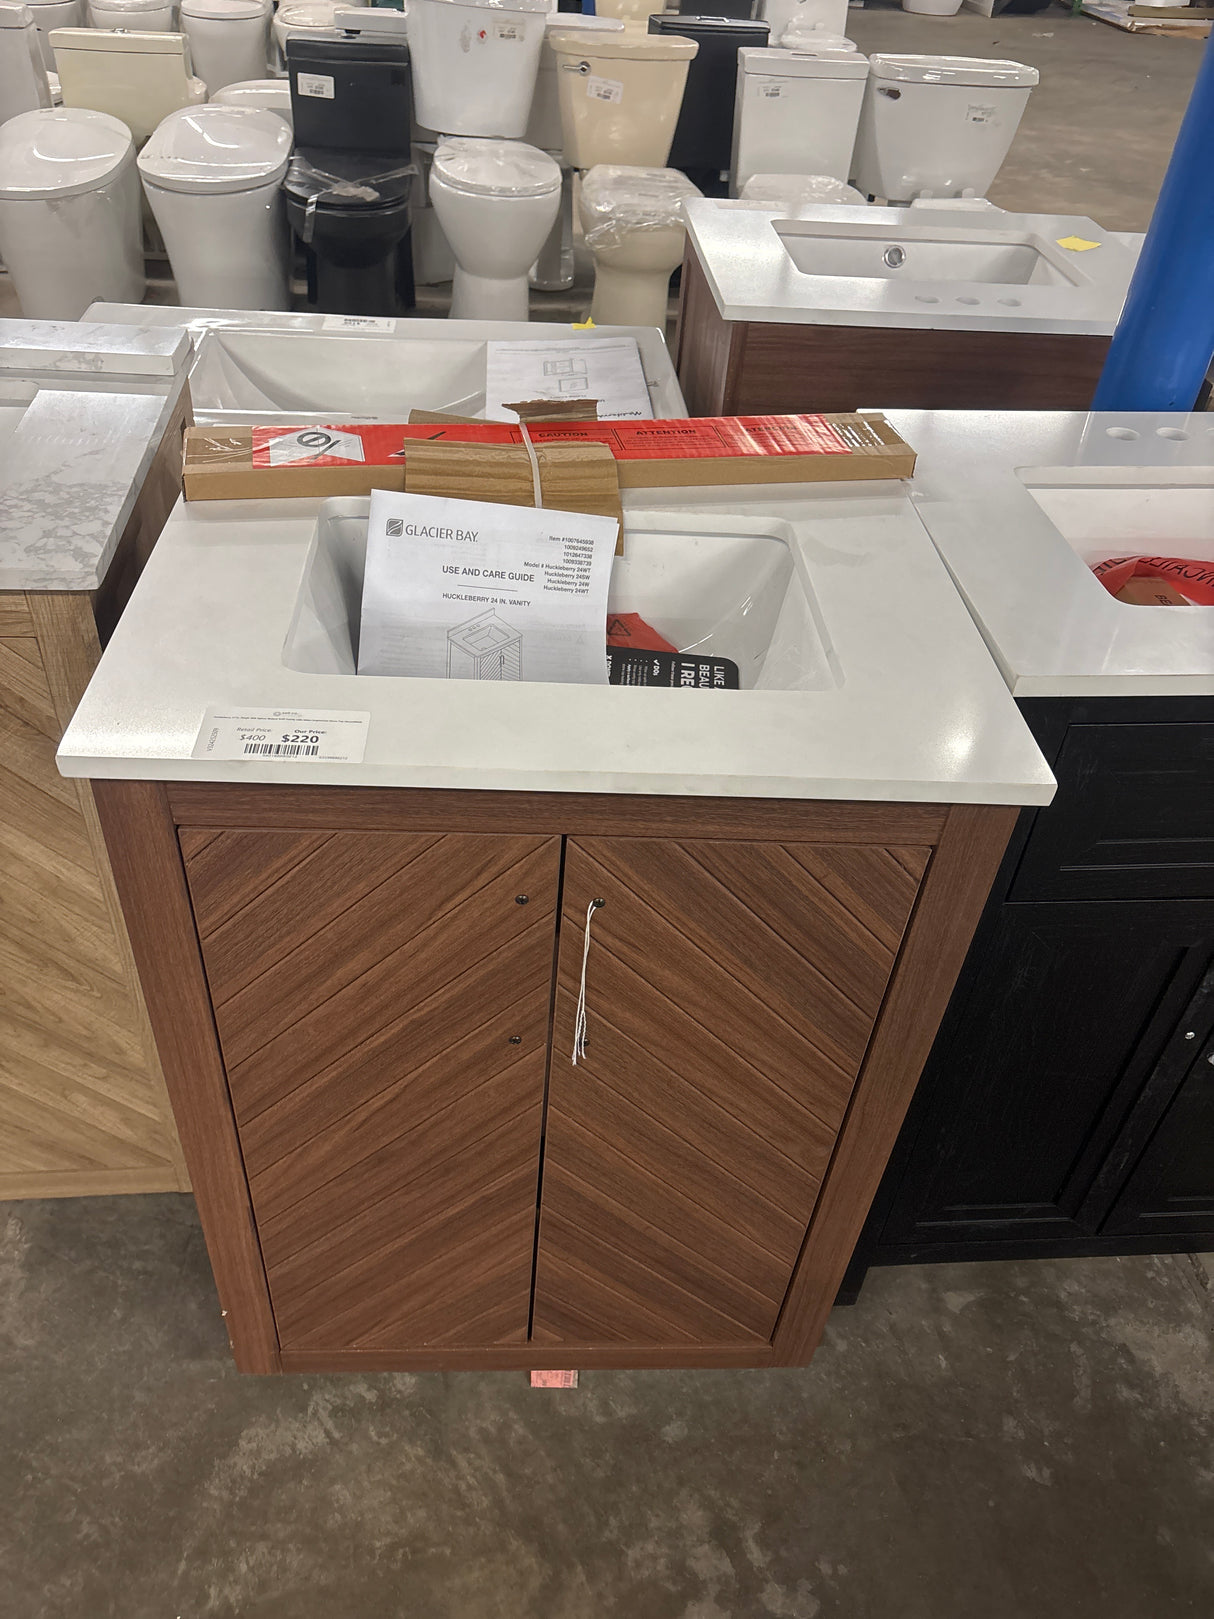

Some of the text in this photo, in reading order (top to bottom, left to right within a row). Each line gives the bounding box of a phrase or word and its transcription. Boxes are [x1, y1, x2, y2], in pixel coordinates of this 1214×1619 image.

[405, 524, 454, 540] GLACIER
[545, 564, 576, 572] Huckleberry
[442, 565, 535, 582] USE AND CARE GUIDE
[544, 571, 575, 579] Huckleberry
[547, 578, 578, 587] Huckleberry
[543, 585, 574, 594] Huckleberry
[442, 593, 490, 604] HUCKLEBERRY
[713, 665, 725, 686] LIKE
[281, 734, 320, 743] $220
